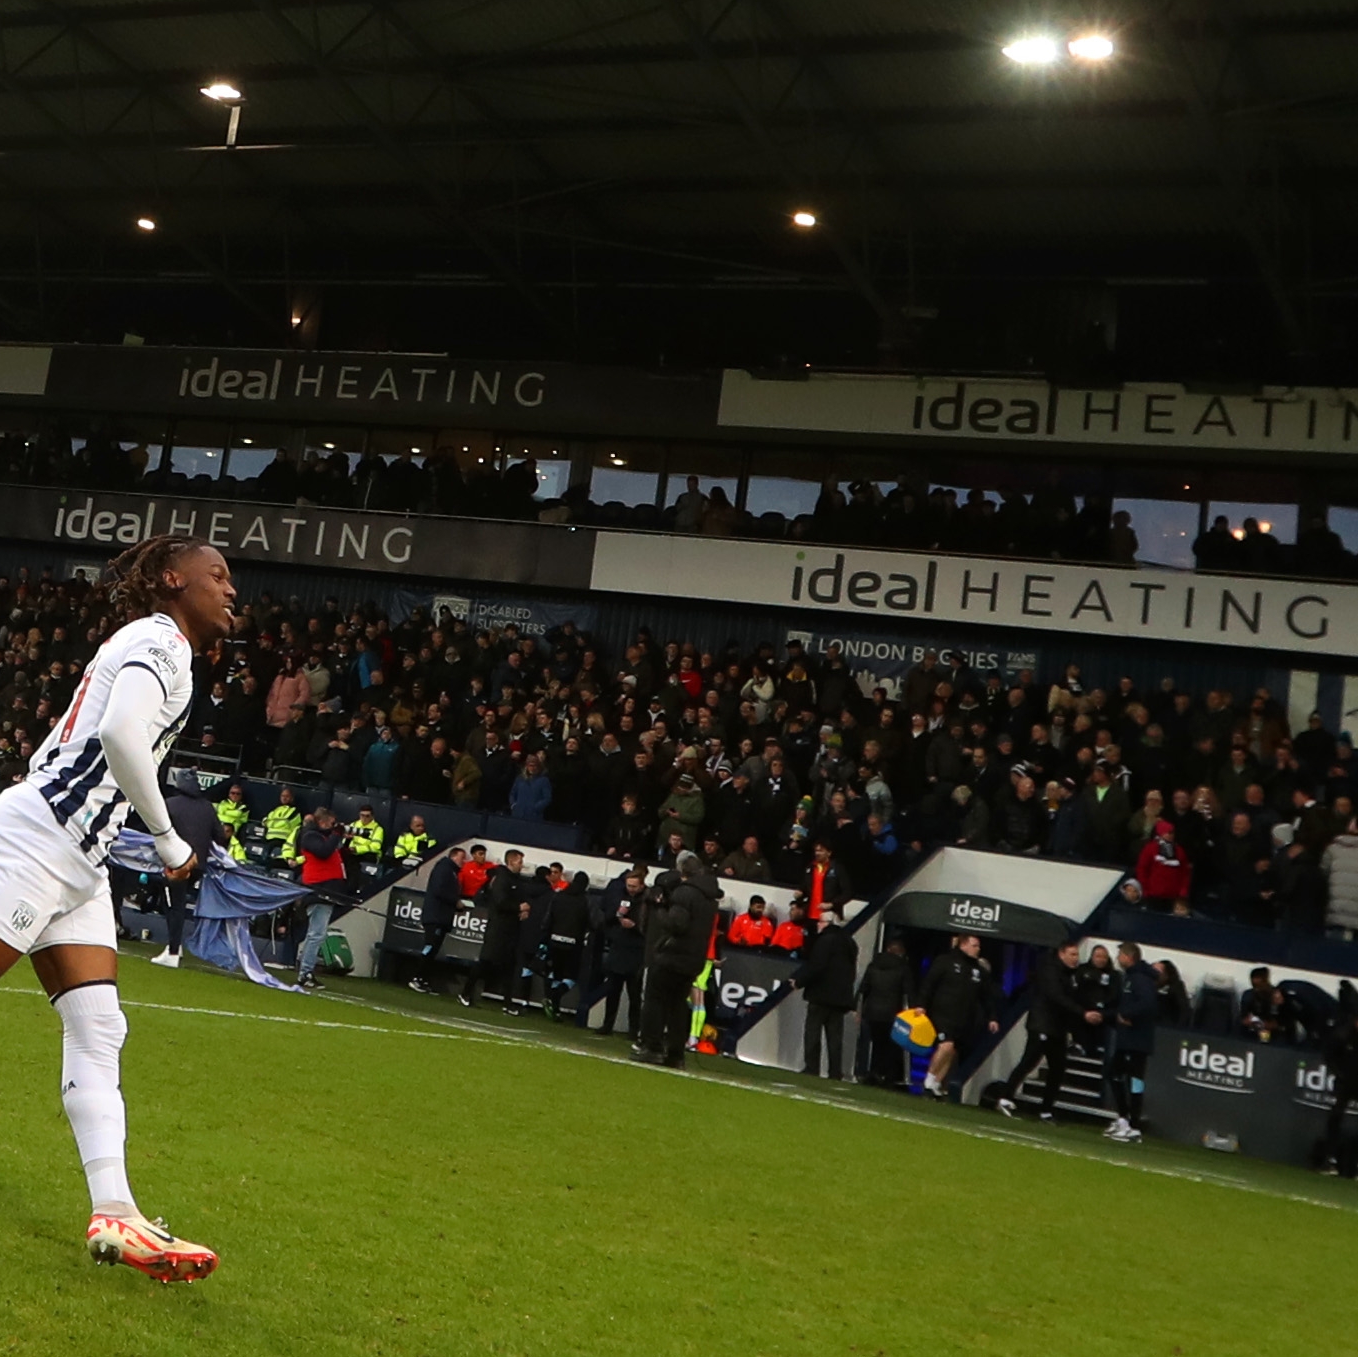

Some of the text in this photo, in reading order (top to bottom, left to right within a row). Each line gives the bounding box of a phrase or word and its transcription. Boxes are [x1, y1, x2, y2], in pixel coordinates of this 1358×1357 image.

[179, 356, 547, 408] ideal HEATING
[913, 379, 1058, 435] ideal
[54, 495, 413, 564] ideal HEATING
[478, 603, 532, 620] DISABLED
[792, 550, 1330, 640] ideal HEATING
[818, 636, 906, 662] LONDON
[950, 898, 1001, 922] ideal
[1179, 1040, 1255, 1079] ideal
[1186, 1069, 1244, 1088] HEATING
